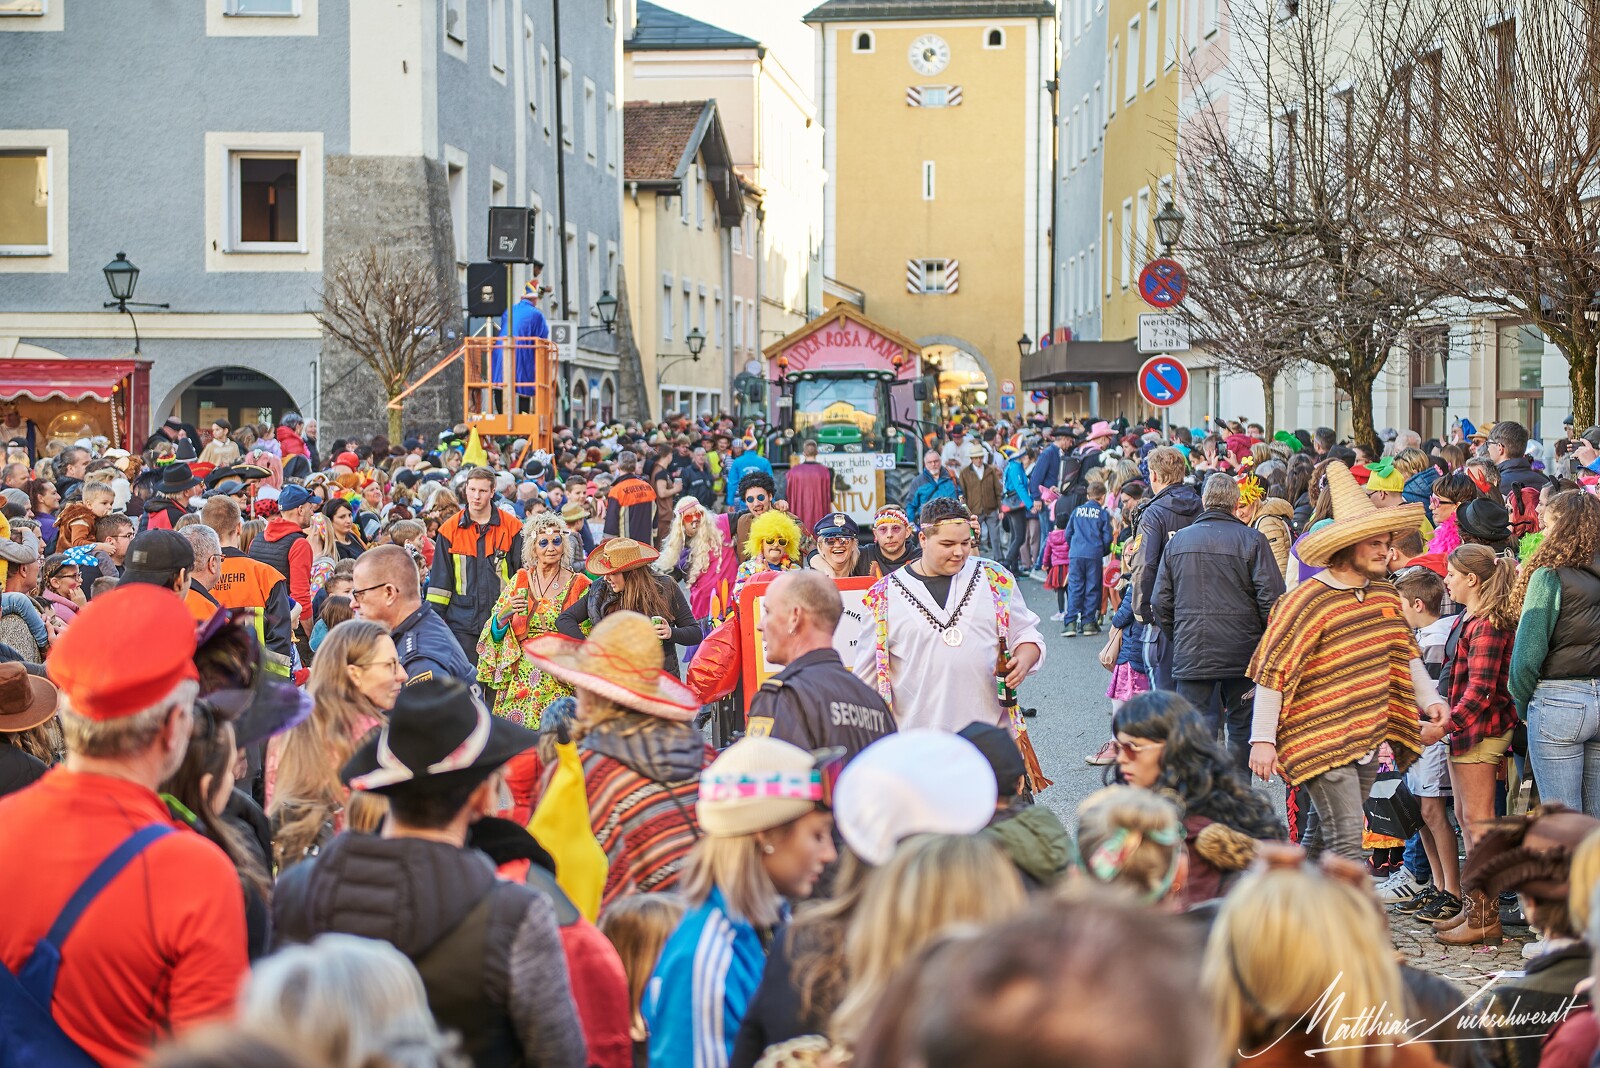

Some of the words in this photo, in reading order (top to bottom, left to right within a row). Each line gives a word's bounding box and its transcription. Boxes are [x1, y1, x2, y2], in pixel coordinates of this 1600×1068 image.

[826, 331, 862, 347] ROSA
[1176, 339, 1181, 347] h
[876, 455, 894, 468] 35
[852, 475, 868, 485] DES
[831, 491, 874, 512] NITU
[1076, 507, 1100, 518] POLICE
[217, 572, 246, 584] WEHR
[213, 583, 232, 591] UFEN
[830, 701, 885, 734] SECURITY
